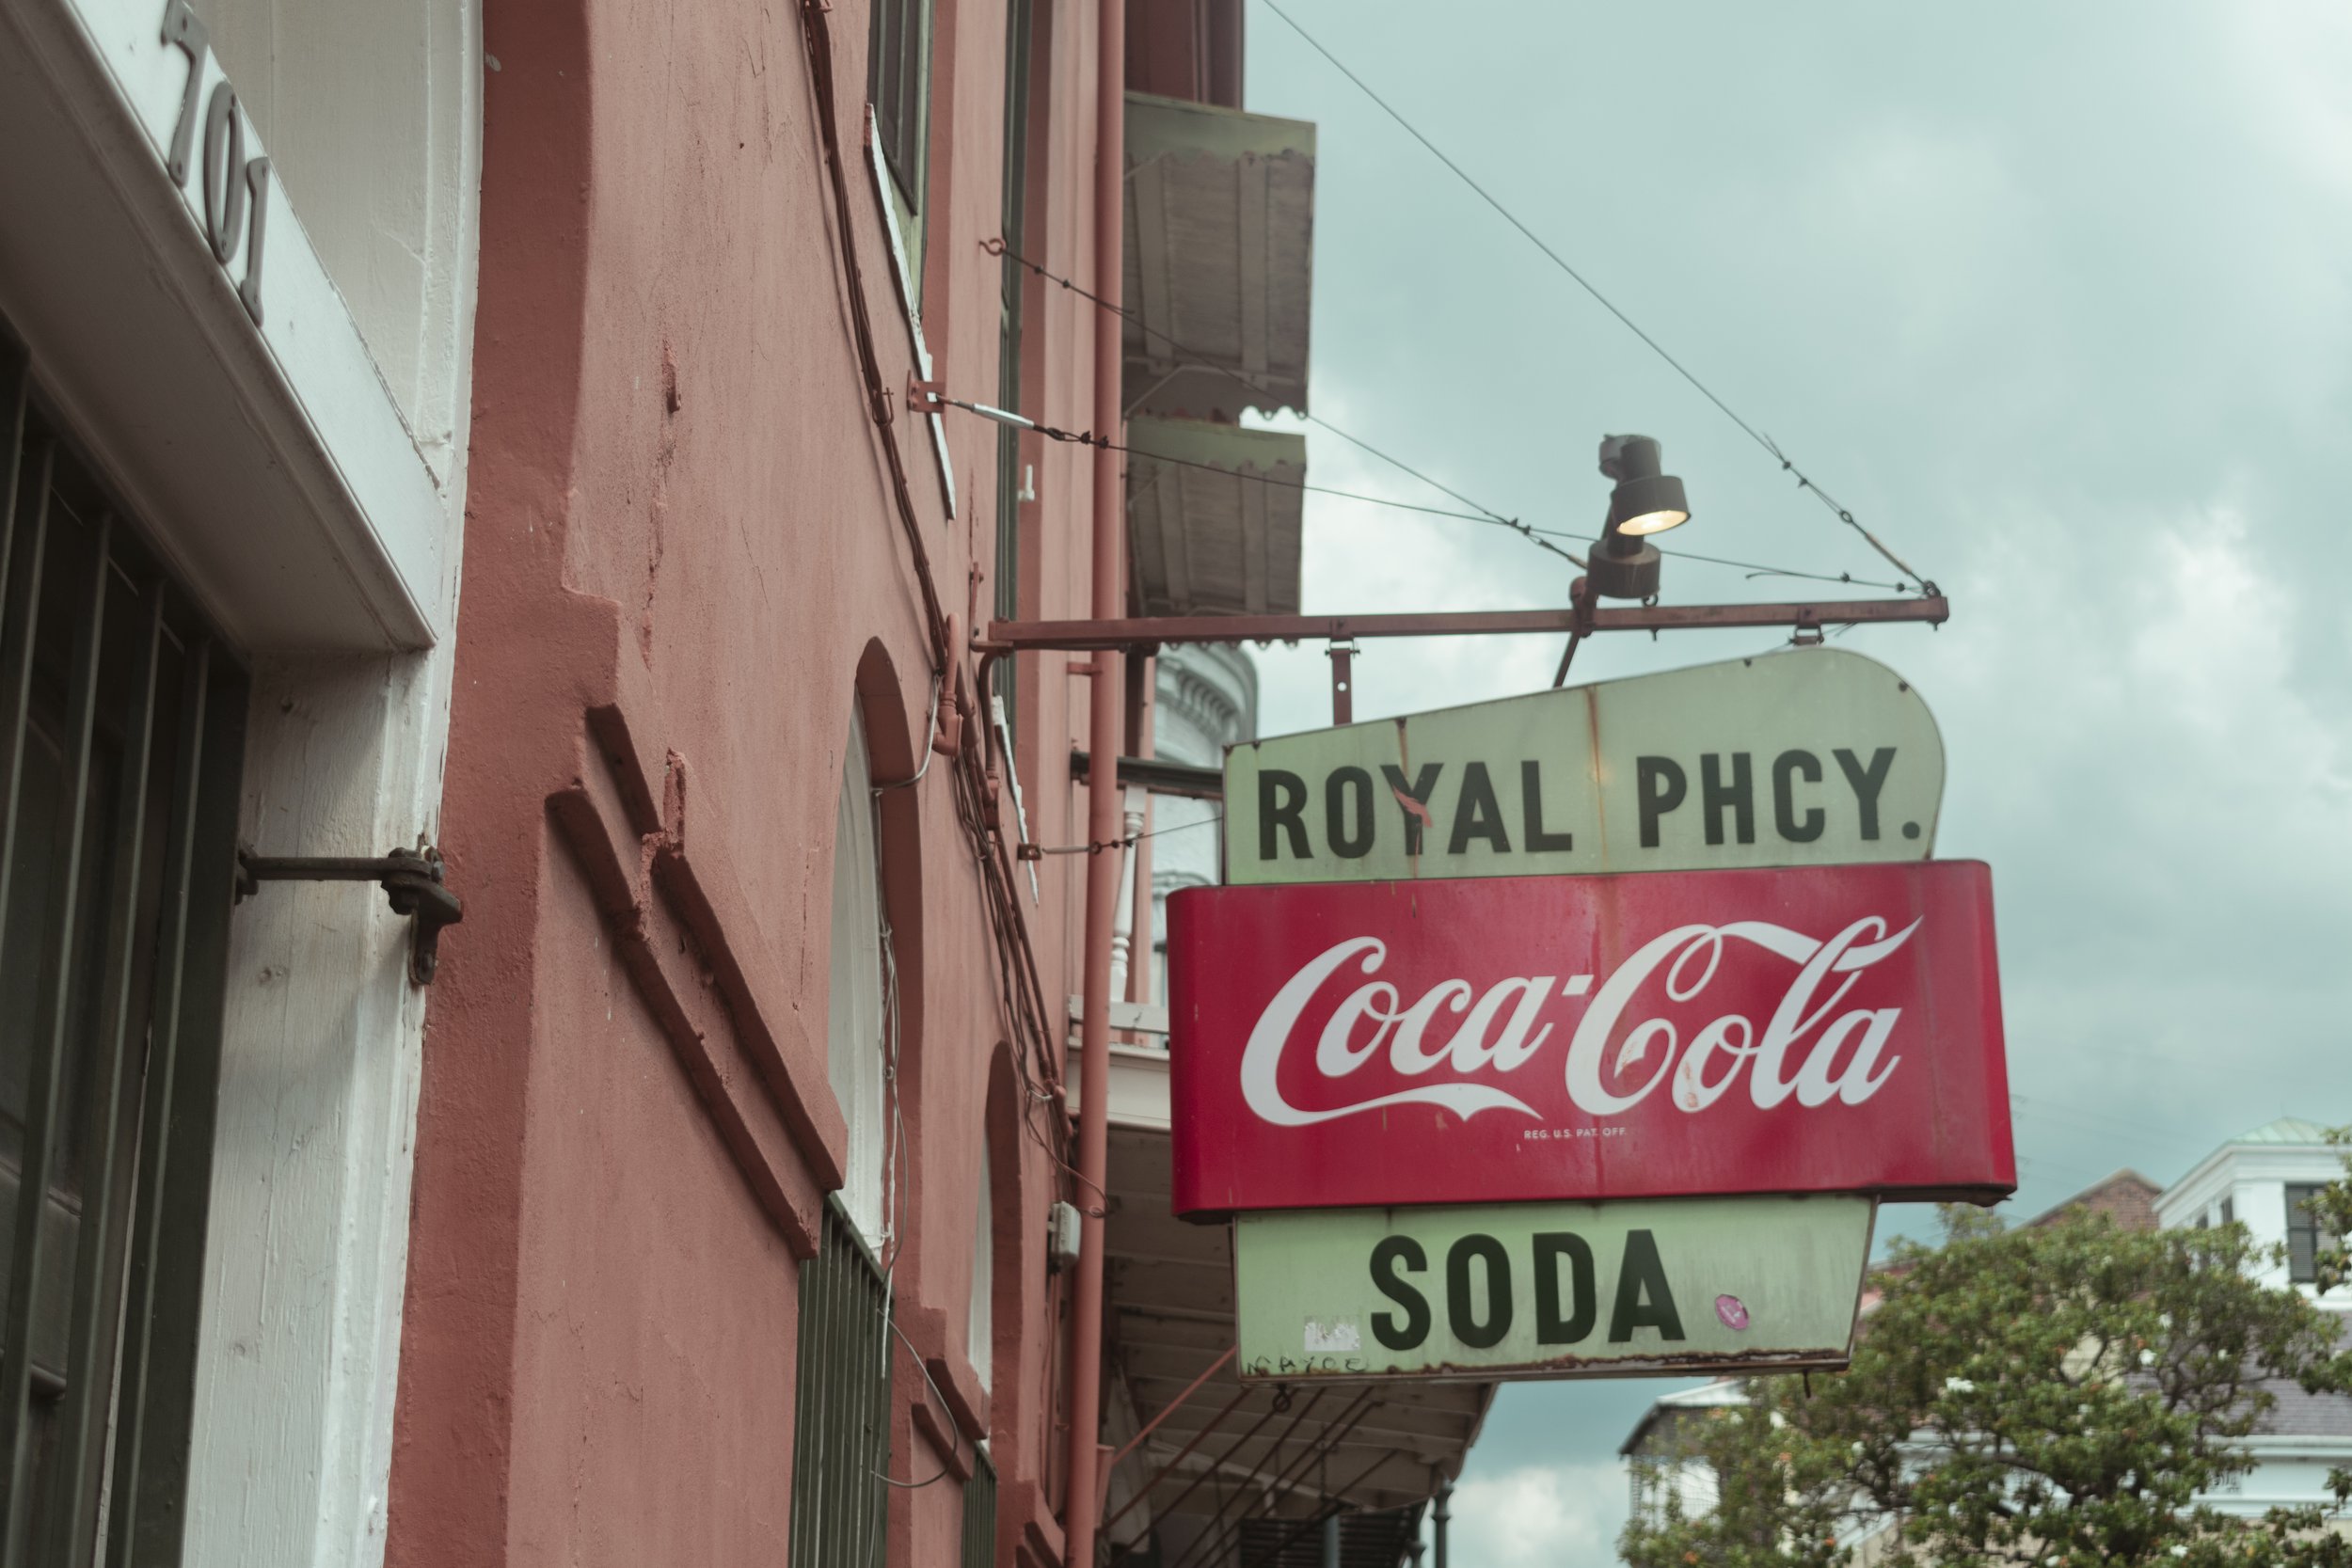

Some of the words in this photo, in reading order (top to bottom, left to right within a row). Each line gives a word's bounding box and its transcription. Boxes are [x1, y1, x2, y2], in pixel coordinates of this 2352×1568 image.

[1258, 760, 1573, 862] ROYAL
[1636, 747, 1921, 848] PHCY.
[1370, 1229, 1686, 1352] SODA
